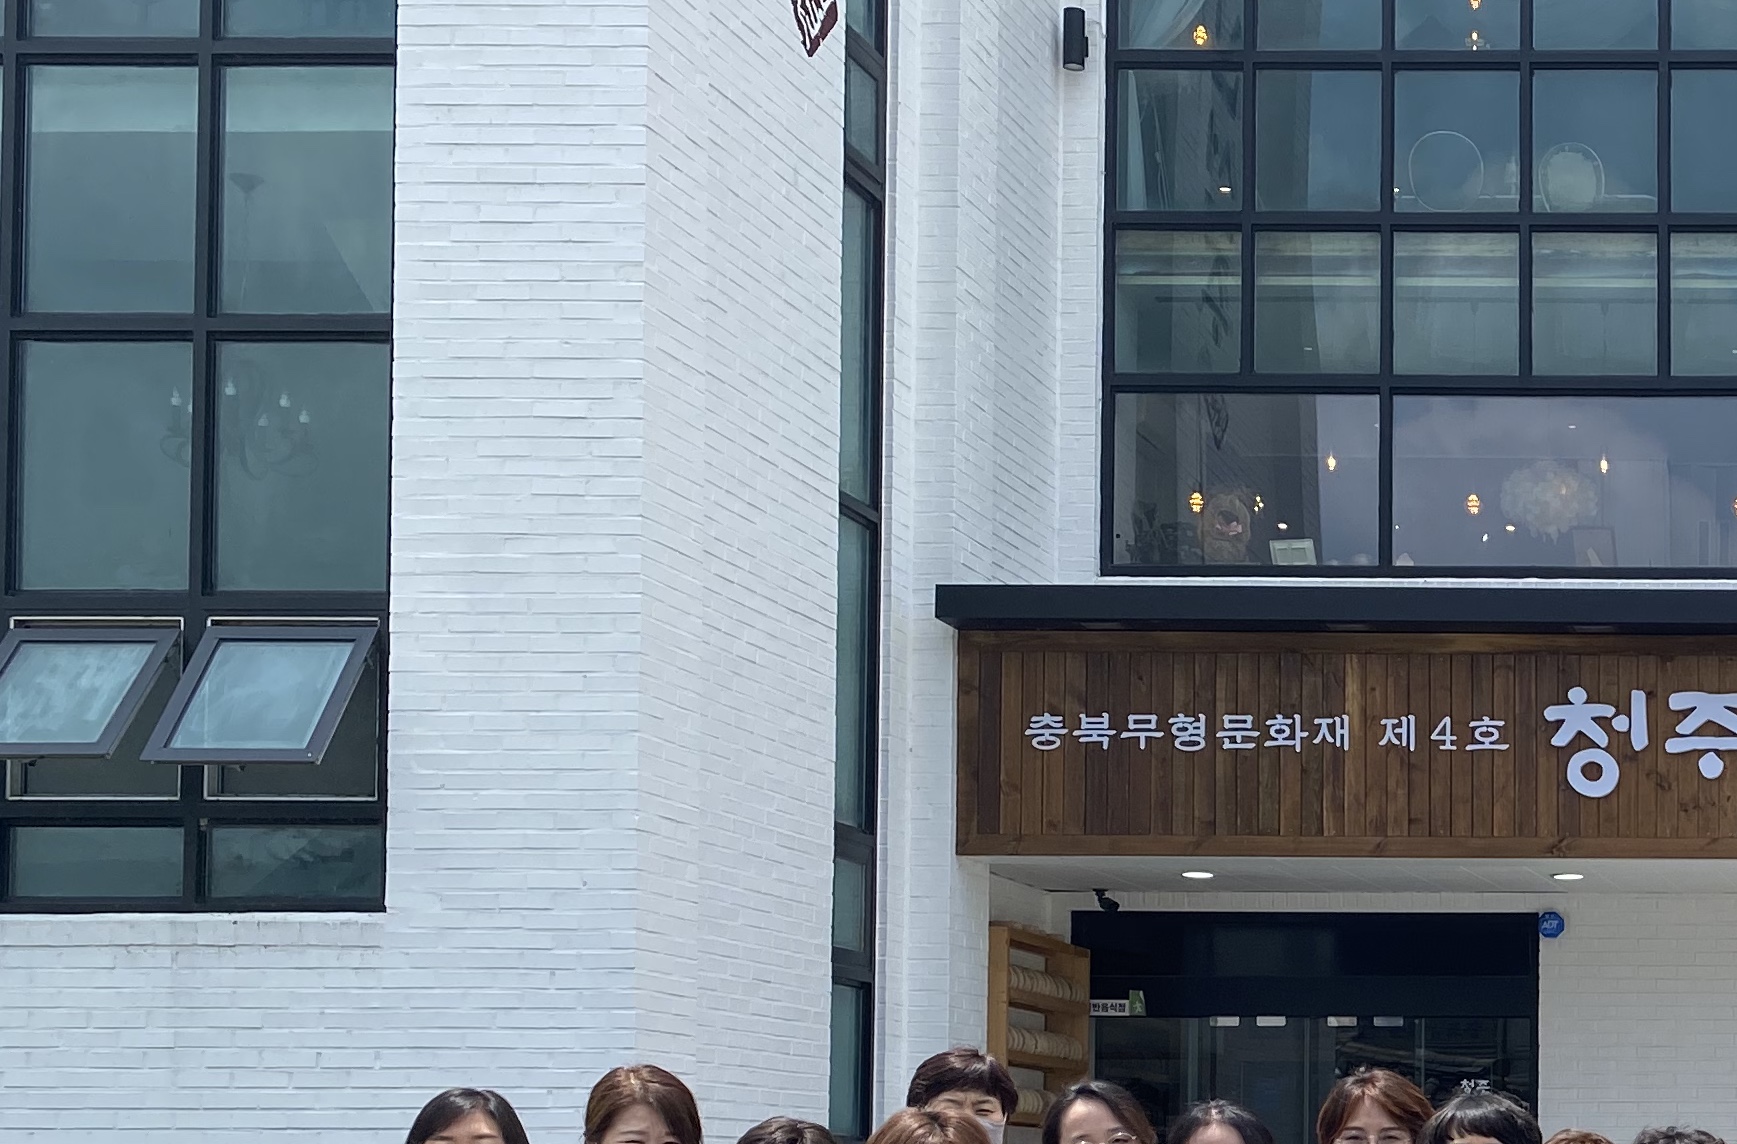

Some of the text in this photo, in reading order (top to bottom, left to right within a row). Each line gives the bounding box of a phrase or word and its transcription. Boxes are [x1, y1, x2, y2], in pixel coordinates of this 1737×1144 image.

[1023, 712, 1350, 753] 충북무형문화재
[1541, 920, 1559, 929] ADT
[1090, 1002, 1126, 1013] 반음식점
